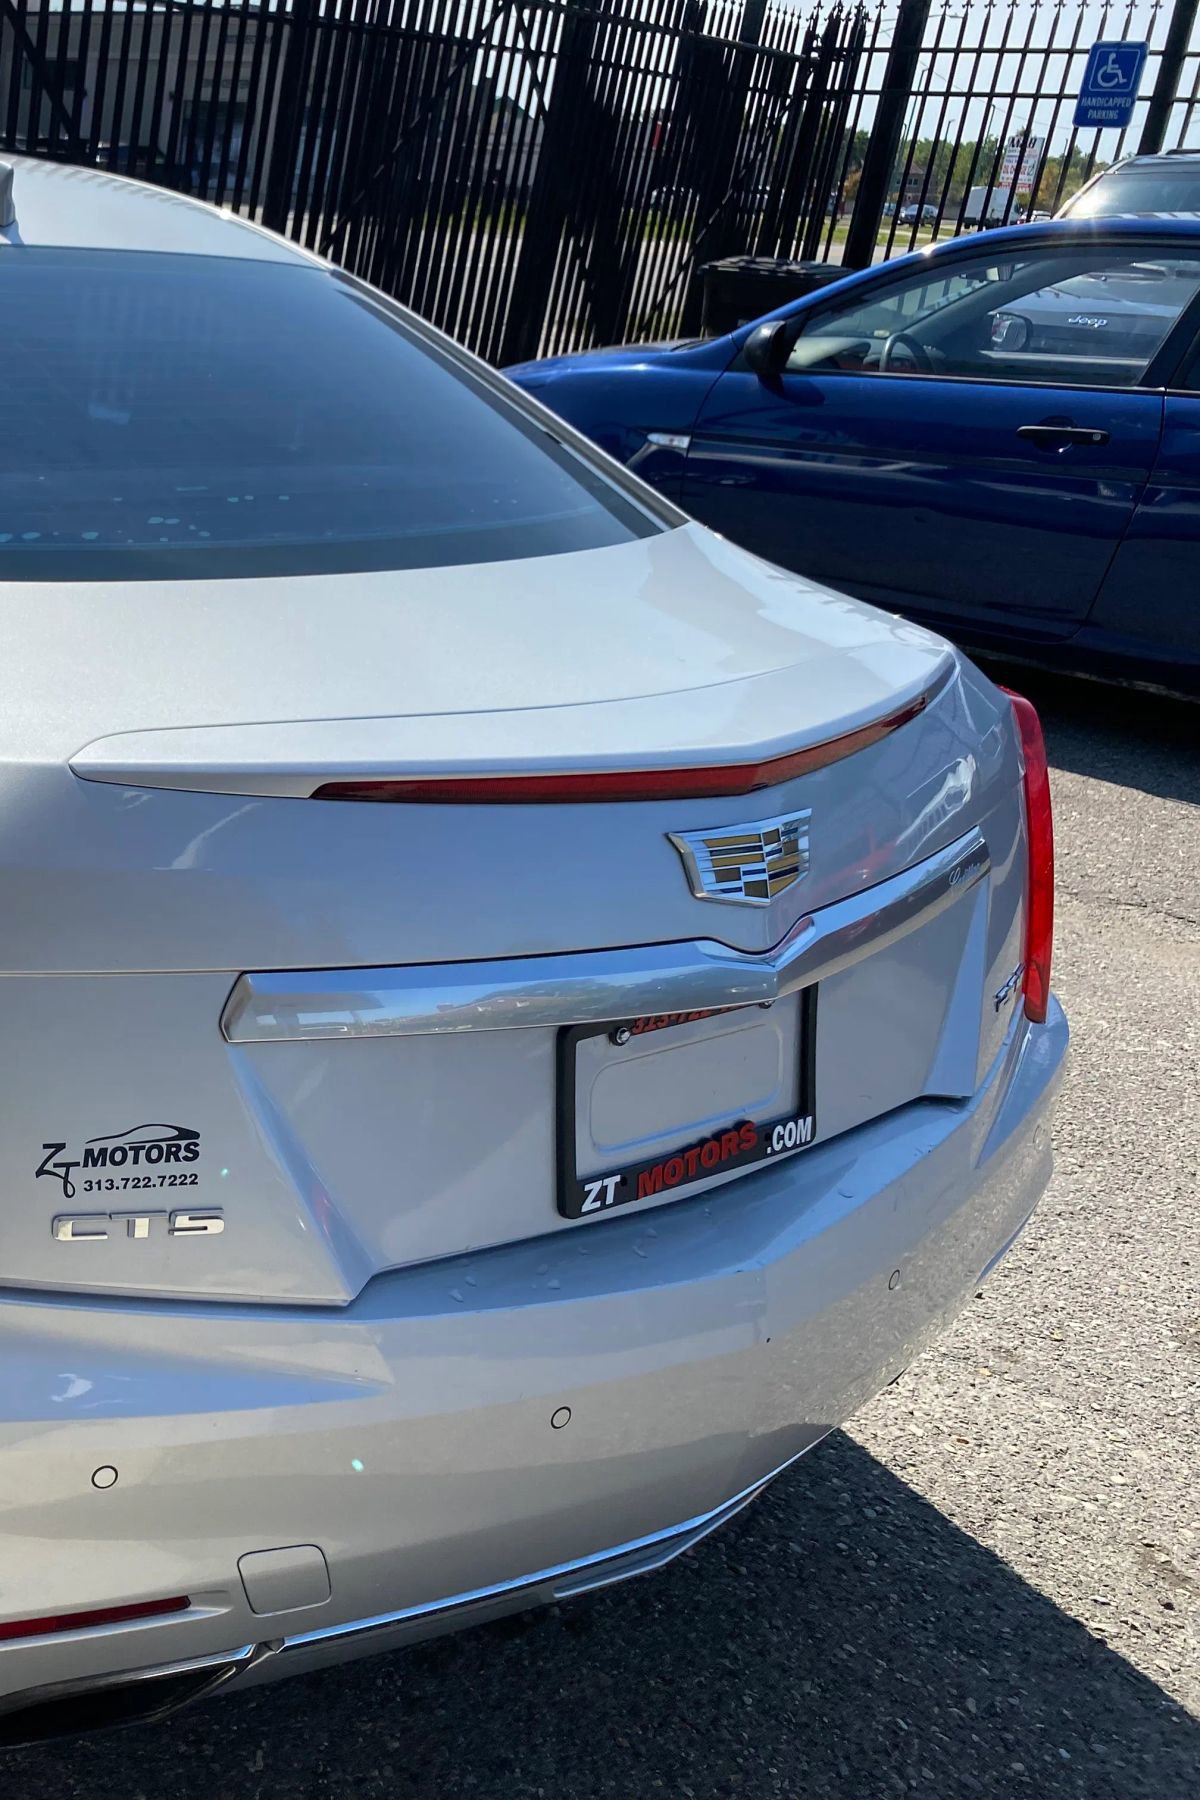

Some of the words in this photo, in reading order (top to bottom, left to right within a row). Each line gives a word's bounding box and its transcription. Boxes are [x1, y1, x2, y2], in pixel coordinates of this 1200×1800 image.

[1081, 96, 1132, 107] HANDICAPPED
[1087, 109, 1119, 119] PARKING
[1068, 315, 1108, 329] Jeep
[82, 1142, 200, 1169] MOTORS
[580, 1174, 621, 1213] ZT
[637, 1120, 758, 1201] MOTORS
[766, 1116, 813, 1154] .COM
[83, 1173, 199, 1192] 313.722.7222
[51, 1207, 225, 1242] CTS
